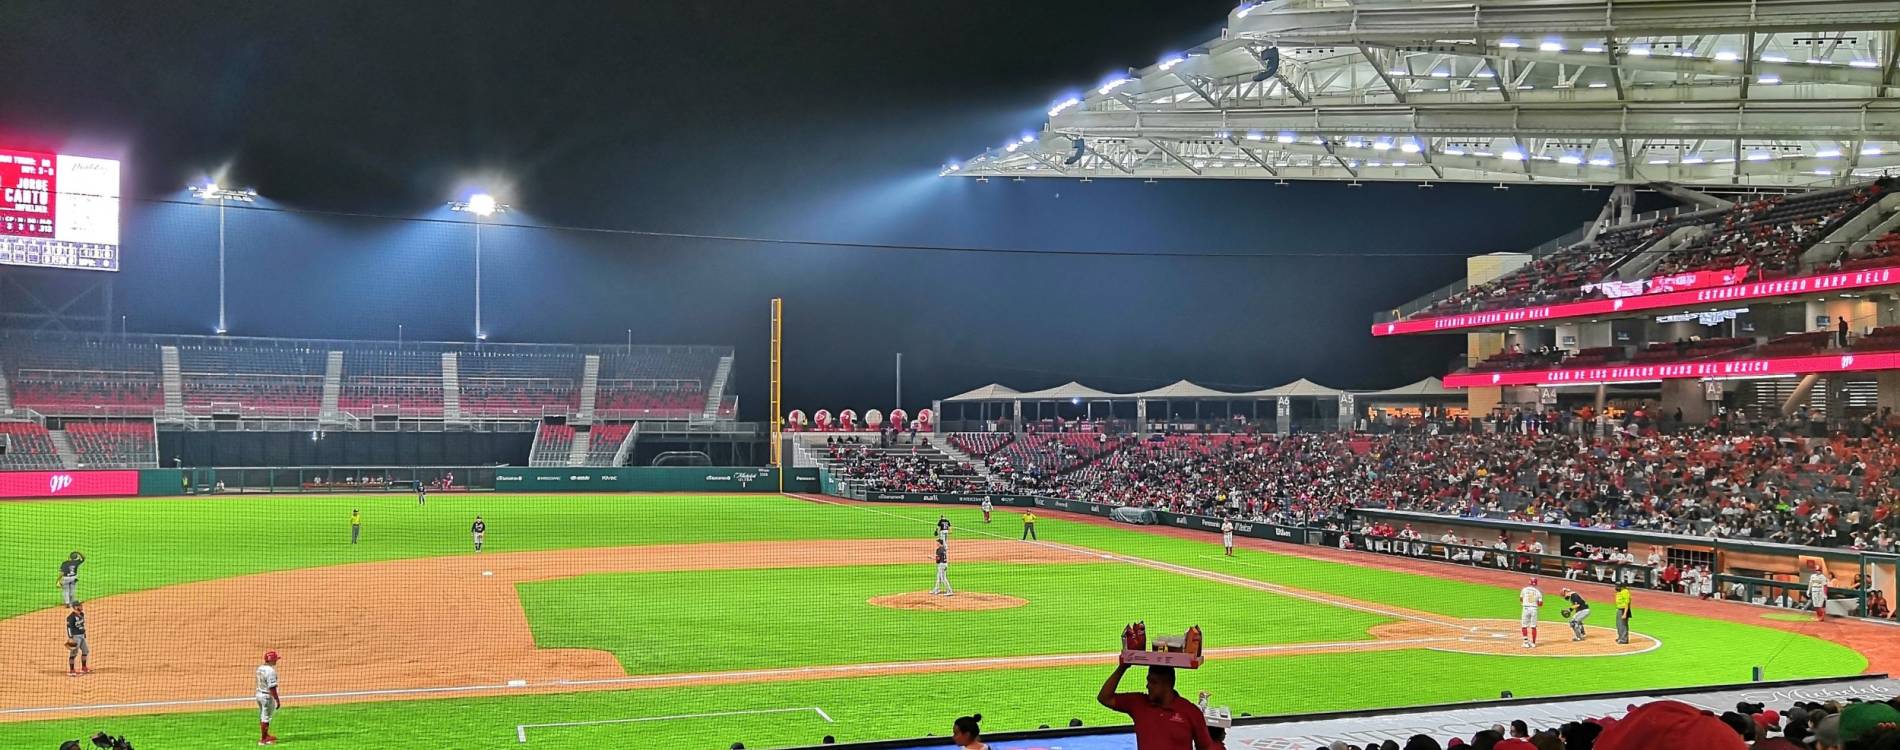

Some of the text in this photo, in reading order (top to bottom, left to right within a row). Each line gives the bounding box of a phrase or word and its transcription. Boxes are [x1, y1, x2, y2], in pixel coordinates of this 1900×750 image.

[17, 178, 48, 191] JORGE
[1698, 286, 1747, 301] ESTADIO
[1753, 279, 1806, 295] ALFREDO
[1814, 274, 1847, 289] HARP
[1548, 361, 1768, 380] CASA DE LOS DIABLOS ROJOS DEL MÉXICO
[1542, 388, 1557, 398] A4
[1278, 396, 1290, 405] A6
[1340, 394, 1354, 404] A5
